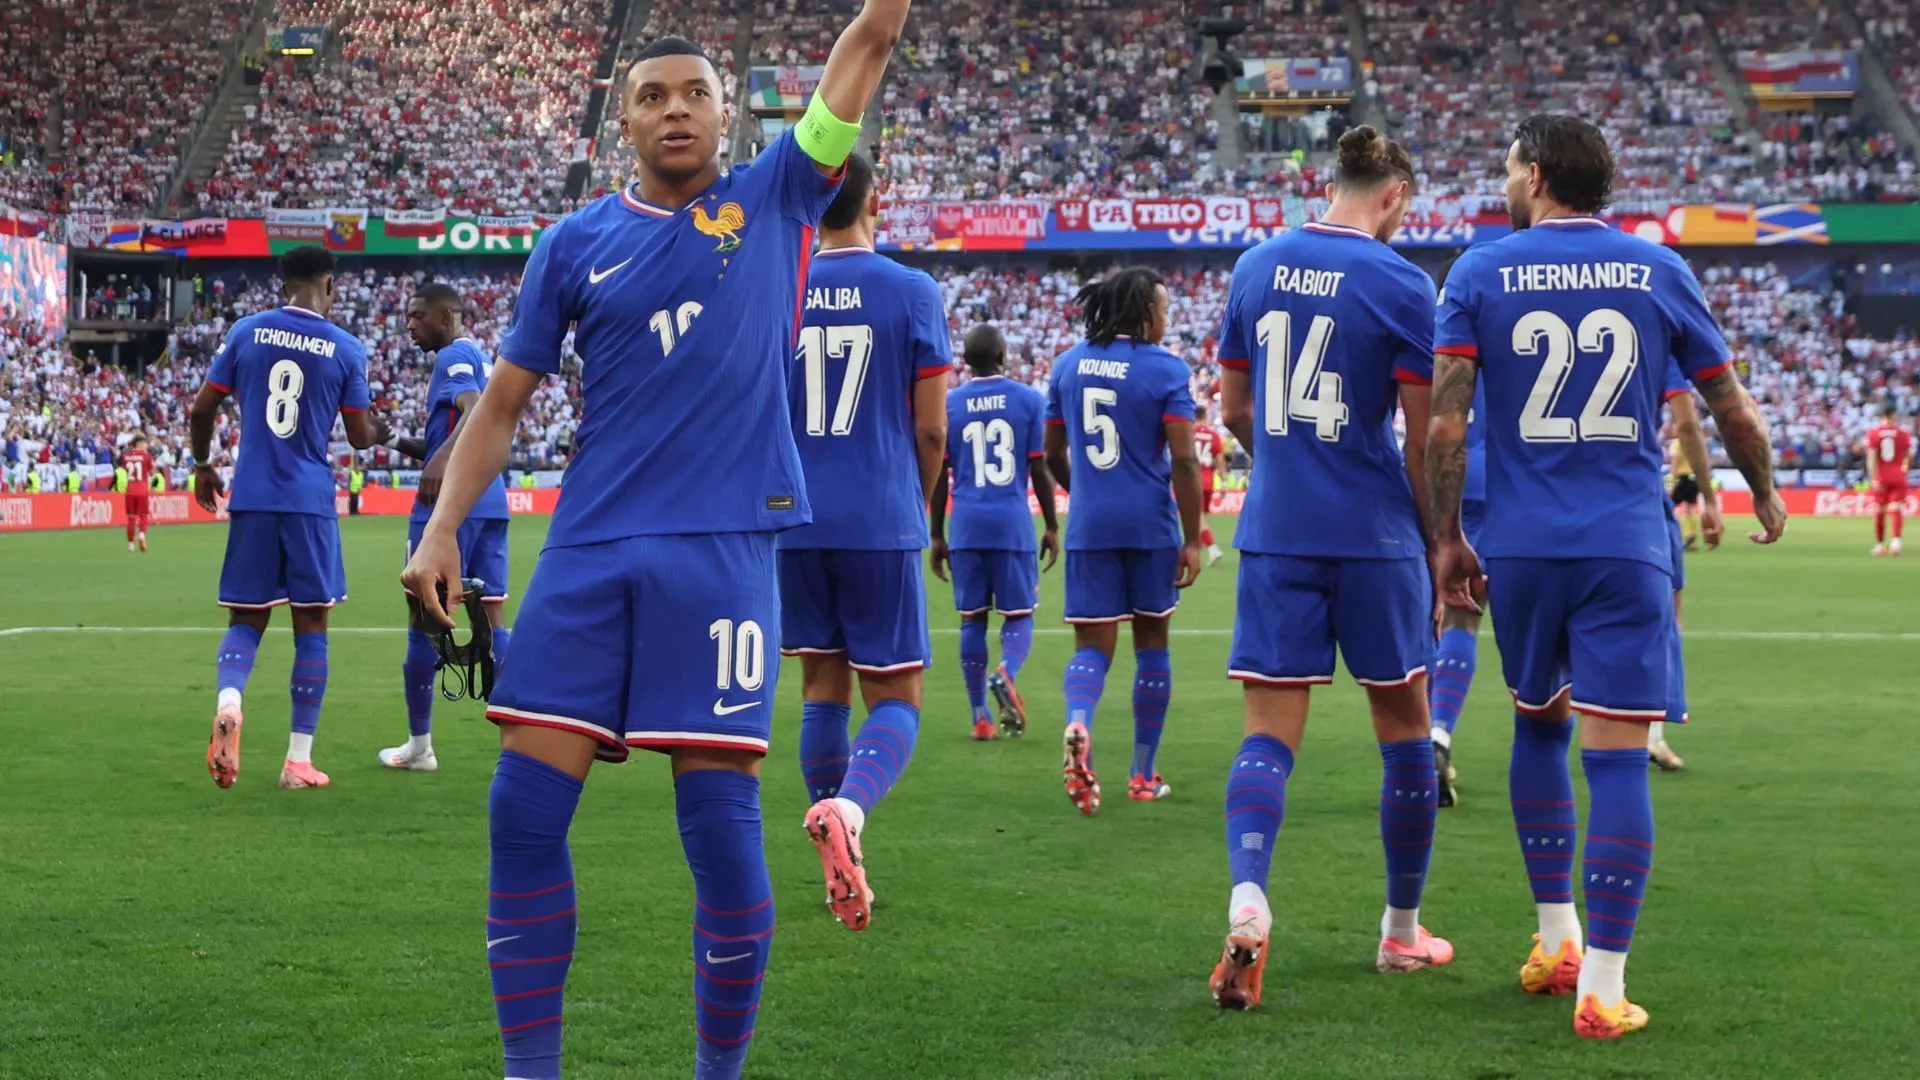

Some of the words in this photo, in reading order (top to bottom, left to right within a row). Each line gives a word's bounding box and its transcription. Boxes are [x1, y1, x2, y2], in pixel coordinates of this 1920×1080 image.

[300, 32, 321, 44] 74
[1321, 67, 1343, 81] 72
[1094, 204, 1127, 222] PA
[1135, 203, 1202, 224] TRIO
[1213, 204, 1243, 222] CI
[1273, 265, 1345, 297] RABIOT
[1499, 262, 1652, 293] T.HERNANDEZ
[254, 328, 336, 359] TCHOUAMENI
[796, 324, 873, 436] 17
[1077, 358, 1130, 379] KOUNDE
[1255, 310, 1349, 442] 14
[1512, 308, 1639, 443] 22
[266, 359, 304, 439] 8
[966, 395, 1006, 412] KANTE
[1082, 387, 1121, 470] 5
[962, 418, 1015, 488] 13
[126, 461, 143, 481] 21
[70, 494, 113, 525] Betano
[1815, 491, 1919, 516] Betao
[709, 618, 764, 691] 10
